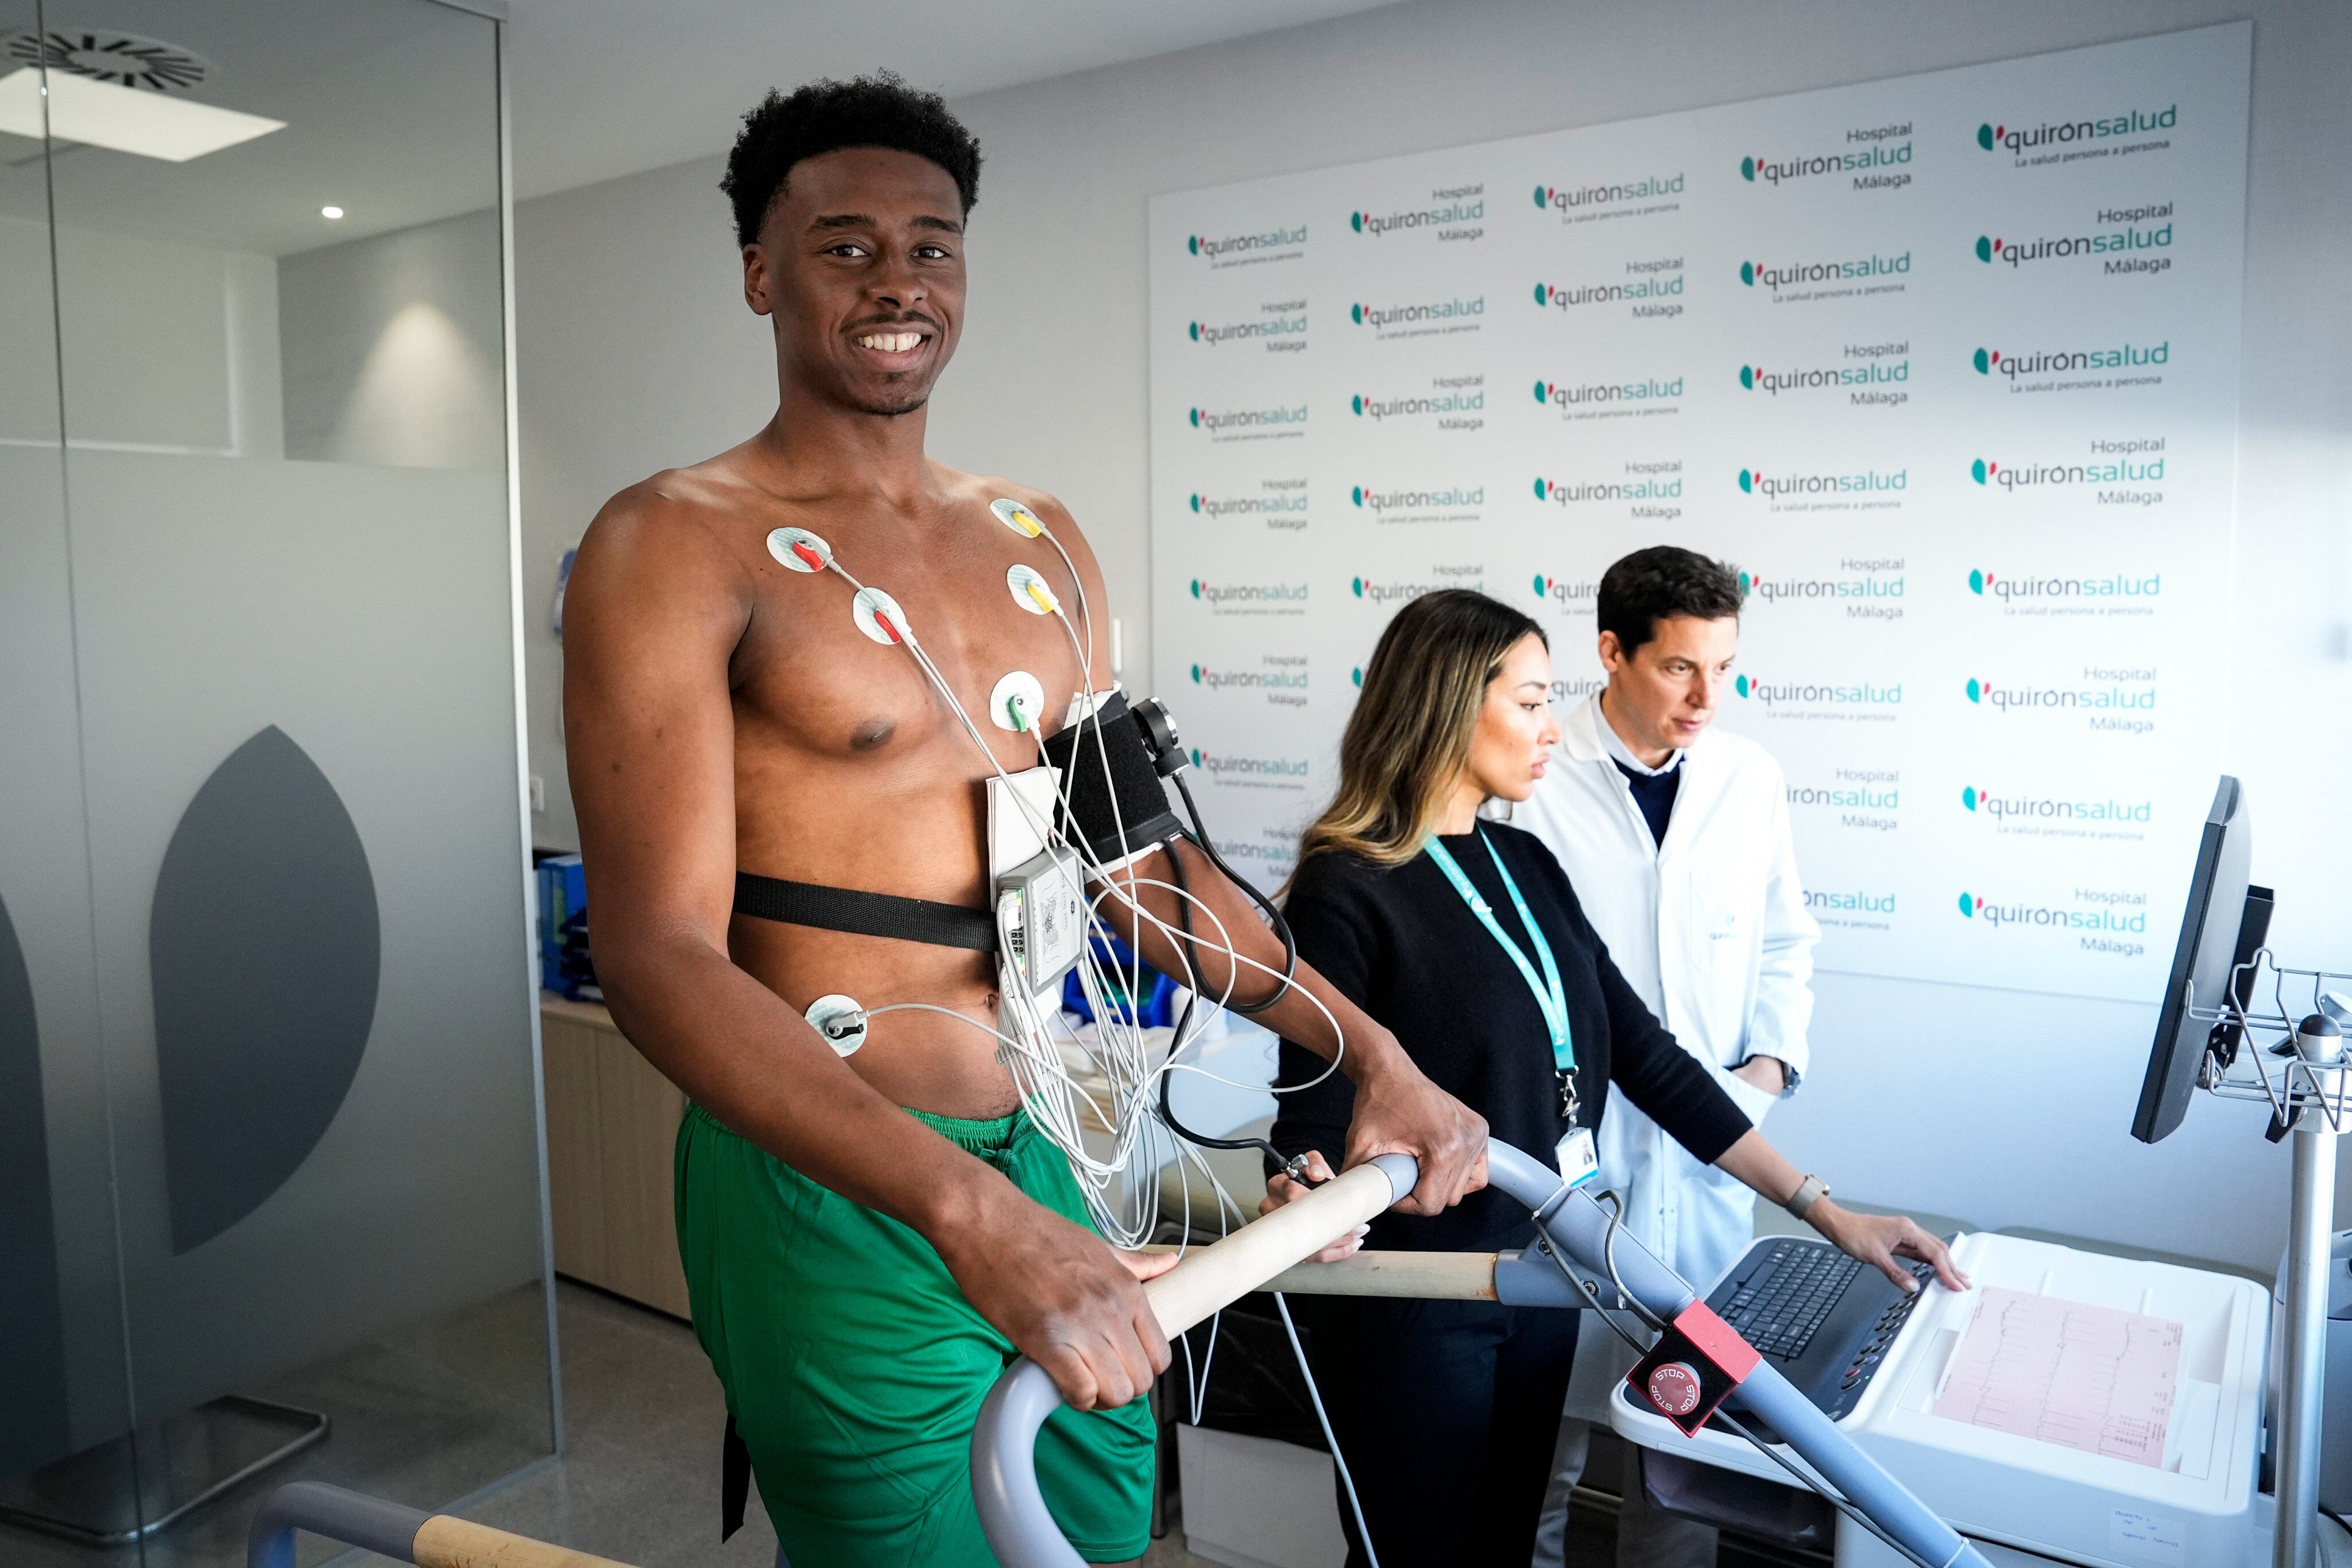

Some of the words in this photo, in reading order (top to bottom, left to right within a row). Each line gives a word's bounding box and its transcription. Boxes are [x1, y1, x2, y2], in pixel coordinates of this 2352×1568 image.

[1846, 121, 1912, 144] Hospital
[2003, 102, 2177, 156] quirónsalud
[1763, 140, 1912, 187] quirónsalud
[2015, 158, 2026, 168] La
[2030, 152, 2060, 166] salud
[2062, 149, 2109, 164] persona
[2121, 140, 2170, 156] persona
[1432, 182, 1483, 201] Hospital
[1553, 171, 1684, 214] quirónsalud
[1853, 173, 1912, 191] Málaga
[2097, 201, 2173, 224] Hospital
[2002, 222, 2173, 269] quirónsalud
[1626, 255, 1684, 274] Hospital
[1763, 249, 1911, 292] quirónsalud
[2103, 257, 2171, 276] Málaga
[1554, 273, 1684, 312] quirónsalud
[1844, 340, 1909, 359] Hospital
[1999, 339, 2169, 381] quirónsalud
[1433, 373, 1484, 390] Hospital
[1762, 359, 1909, 397] quirónsalud
[2010, 384, 2022, 393] La
[2025, 381, 2055, 392] salud
[2056, 381, 2102, 392] persona
[2114, 376, 2163, 389] persona
[1553, 375, 1683, 410] quirónsalud
[1850, 390, 1908, 406] Málaga
[2090, 436, 2165, 456] Hospital
[1625, 459, 1682, 476] Hospital
[1997, 456, 2165, 493] quirónsalud
[1553, 477, 1682, 508] quirónsalud
[1761, 467, 1907, 501] quirónsalud
[2097, 489, 2163, 507] Málaga
[1840, 556, 1905, 573] Hospital
[1759, 575, 1905, 604] quirónsalud
[1993, 572, 2161, 603] quirónsalud
[1846, 604, 1904, 621] Málaga
[2083, 667, 2157, 684] Hospital
[1757, 682, 1902, 707] quirónsalud
[1990, 686, 2156, 713] quirónsalud
[2089, 716, 2154, 735] Málaga
[1835, 767, 1900, 784] Hospital
[1786, 784, 1899, 809] irónsalud
[1986, 795, 2152, 822] quirónsalud
[1841, 814, 1898, 833] Málaga
[2074, 887, 2147, 907] Hospital
[1983, 903, 2146, 934] quirónsalud
[2080, 936, 2144, 958] Málaga
[1655, 1369, 1685, 1380] STOP
[1651, 1385, 1673, 1411] STOP
[1680, 1384, 1695, 1411] STOP
